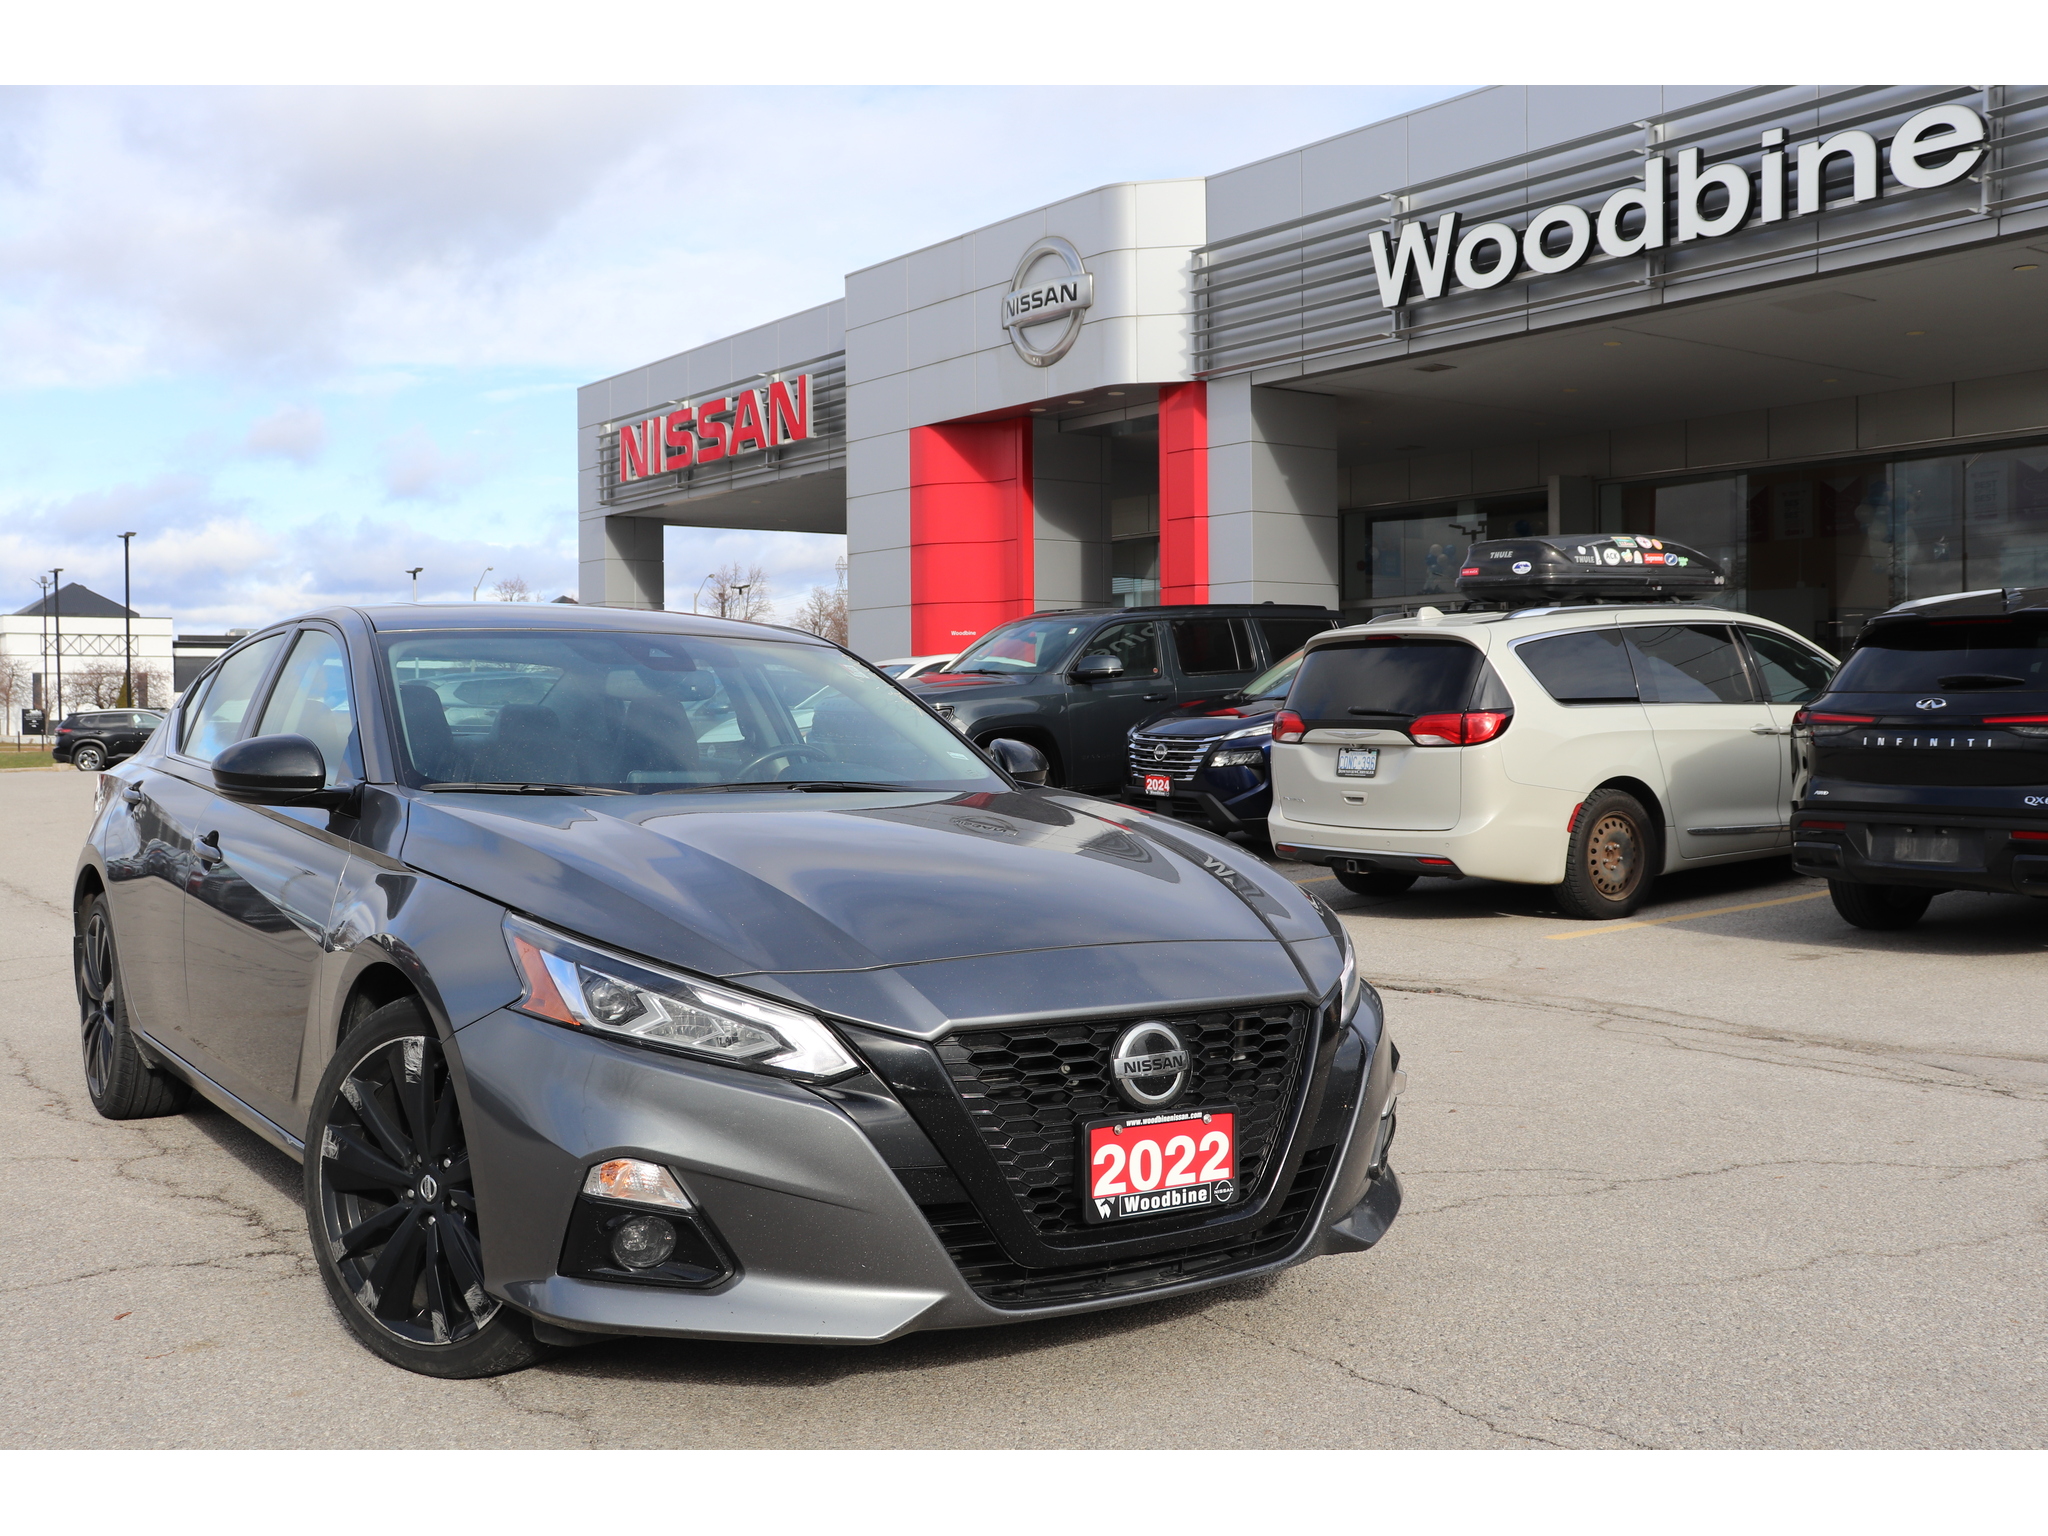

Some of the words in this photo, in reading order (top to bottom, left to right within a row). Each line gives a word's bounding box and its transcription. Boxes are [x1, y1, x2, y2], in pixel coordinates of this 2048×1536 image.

[1368, 103, 1989, 309] Woodbine
[1006, 281, 1077, 319] NISSAN
[619, 374, 813, 482] NISSAN
[1490, 551, 1513, 559] THULE
[1574, 555, 1595, 563] THULE
[1645, 553, 1664, 563] Supreme
[1863, 736, 1992, 748] INFINITI
[1361, 756, 1376, 770] 396
[1147, 778, 1170, 791] 2024
[1123, 1055, 1184, 1074] NISSAN
[1126, 1111, 1203, 1127] www.woodbinenissan.com
[1093, 1130, 1230, 1197] 2022
[1214, 1187, 1234, 1196] NISSAN
[1124, 1186, 1208, 1213] Woodbine
